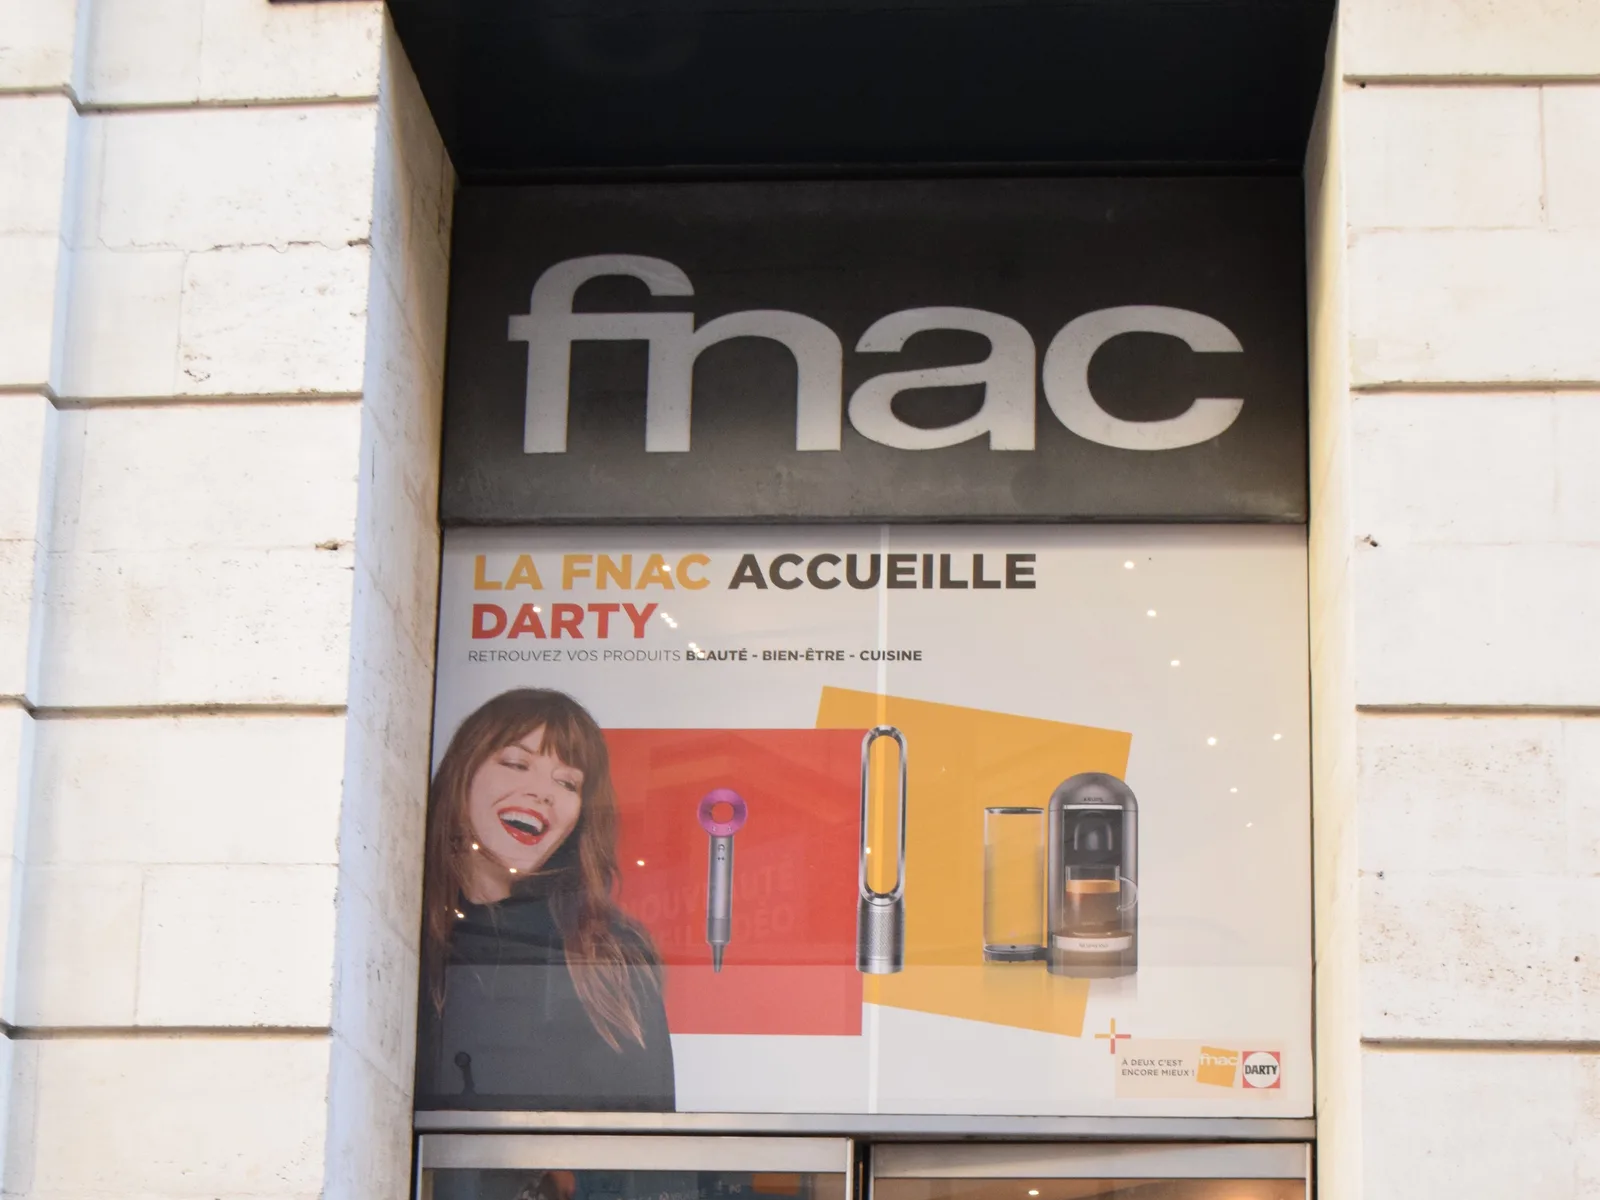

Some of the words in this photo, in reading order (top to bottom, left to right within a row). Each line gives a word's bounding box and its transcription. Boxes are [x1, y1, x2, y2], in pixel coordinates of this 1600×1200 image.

[508, 253, 1244, 454] fnac
[473, 553, 543, 590] LA
[562, 553, 711, 590] FNAC
[728, 553, 1037, 590] ACCUEILLE
[471, 602, 659, 639] DARTY
[468, 649, 561, 662] RETROUVEZ
[568, 649, 598, 662] VOS
[603, 649, 681, 662] PRODUITS
[686, 648, 748, 661] BEAUTÉ
[762, 647, 845, 661] BIEN-ÊTRE
[859, 649, 923, 661] CUISINE
[1131, 1059, 1155, 1067] DEUX
[1158, 1059, 1183, 1067] C'EST
[1200, 1053, 1238, 1066] fnac
[1121, 1068, 1159, 1076] ENCORE
[1244, 1064, 1278, 1075] DARTY
